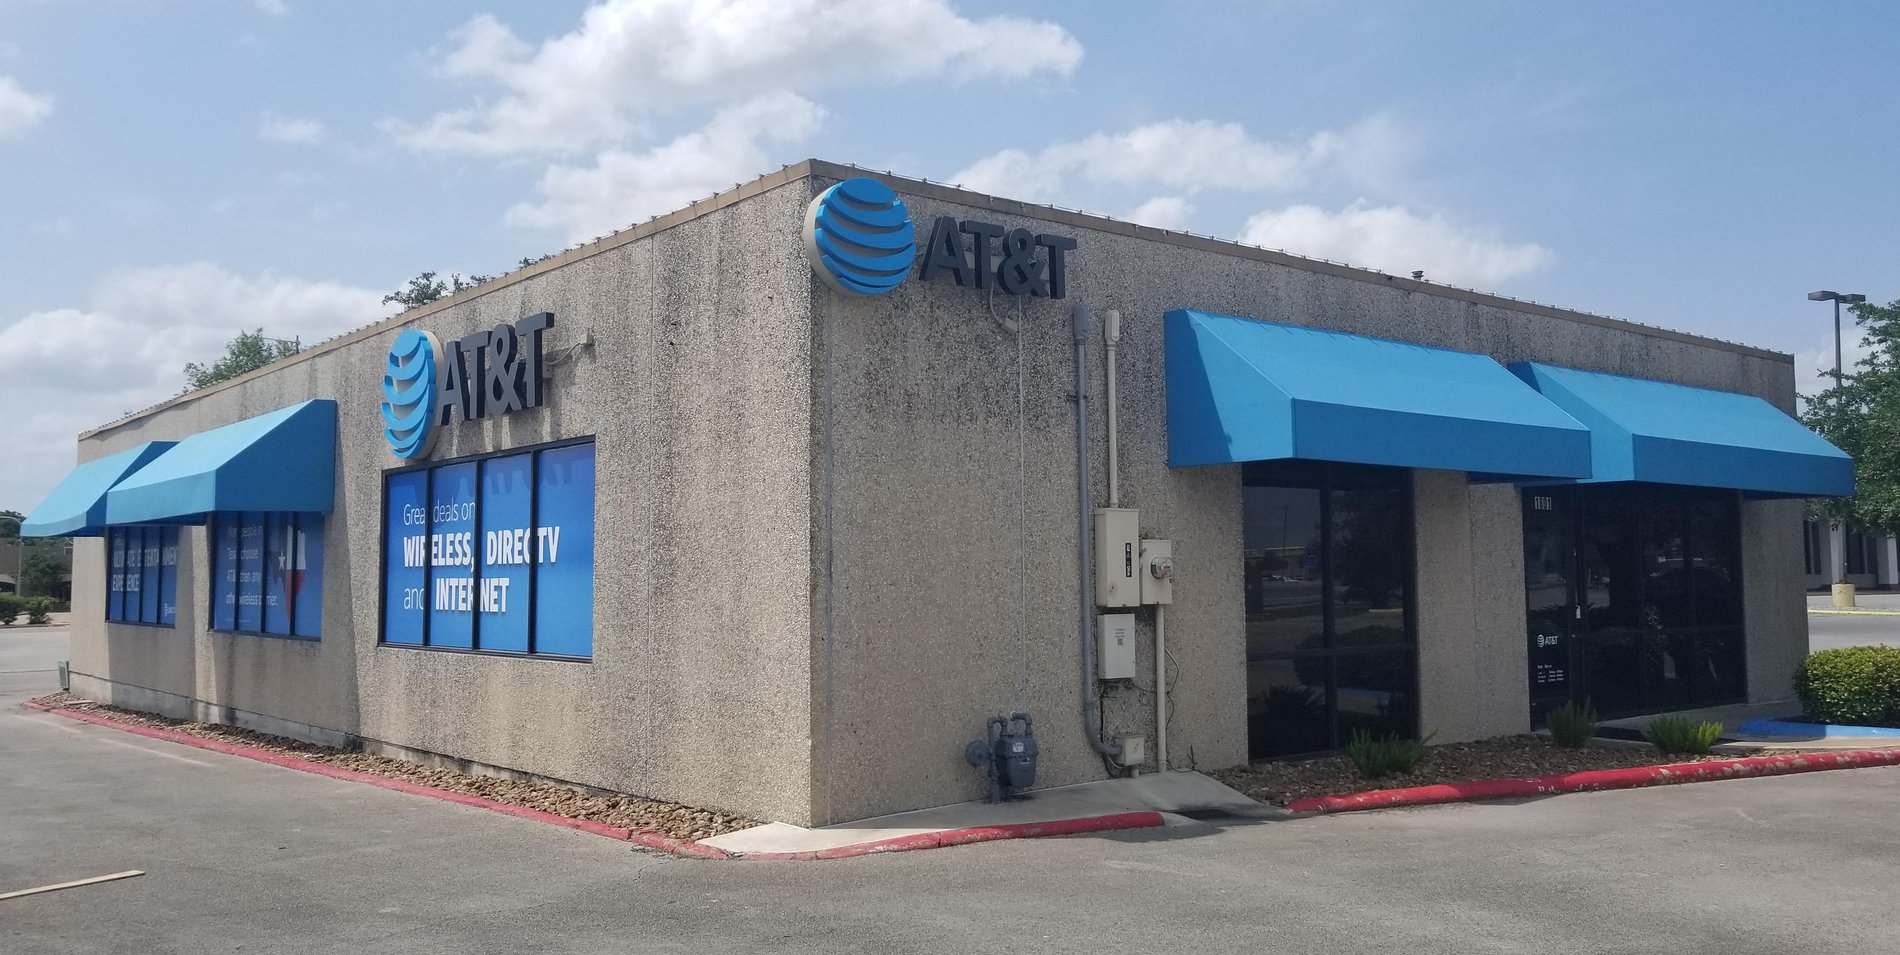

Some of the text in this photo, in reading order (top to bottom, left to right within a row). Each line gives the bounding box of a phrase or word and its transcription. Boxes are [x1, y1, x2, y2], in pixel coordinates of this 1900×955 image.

[918, 215, 1078, 299] AT&T
[434, 311, 555, 427] AT&T
[403, 497, 476, 526] Grea deals on
[486, 526, 561, 565] DIRECTV
[435, 577, 510, 612] INTERNET
